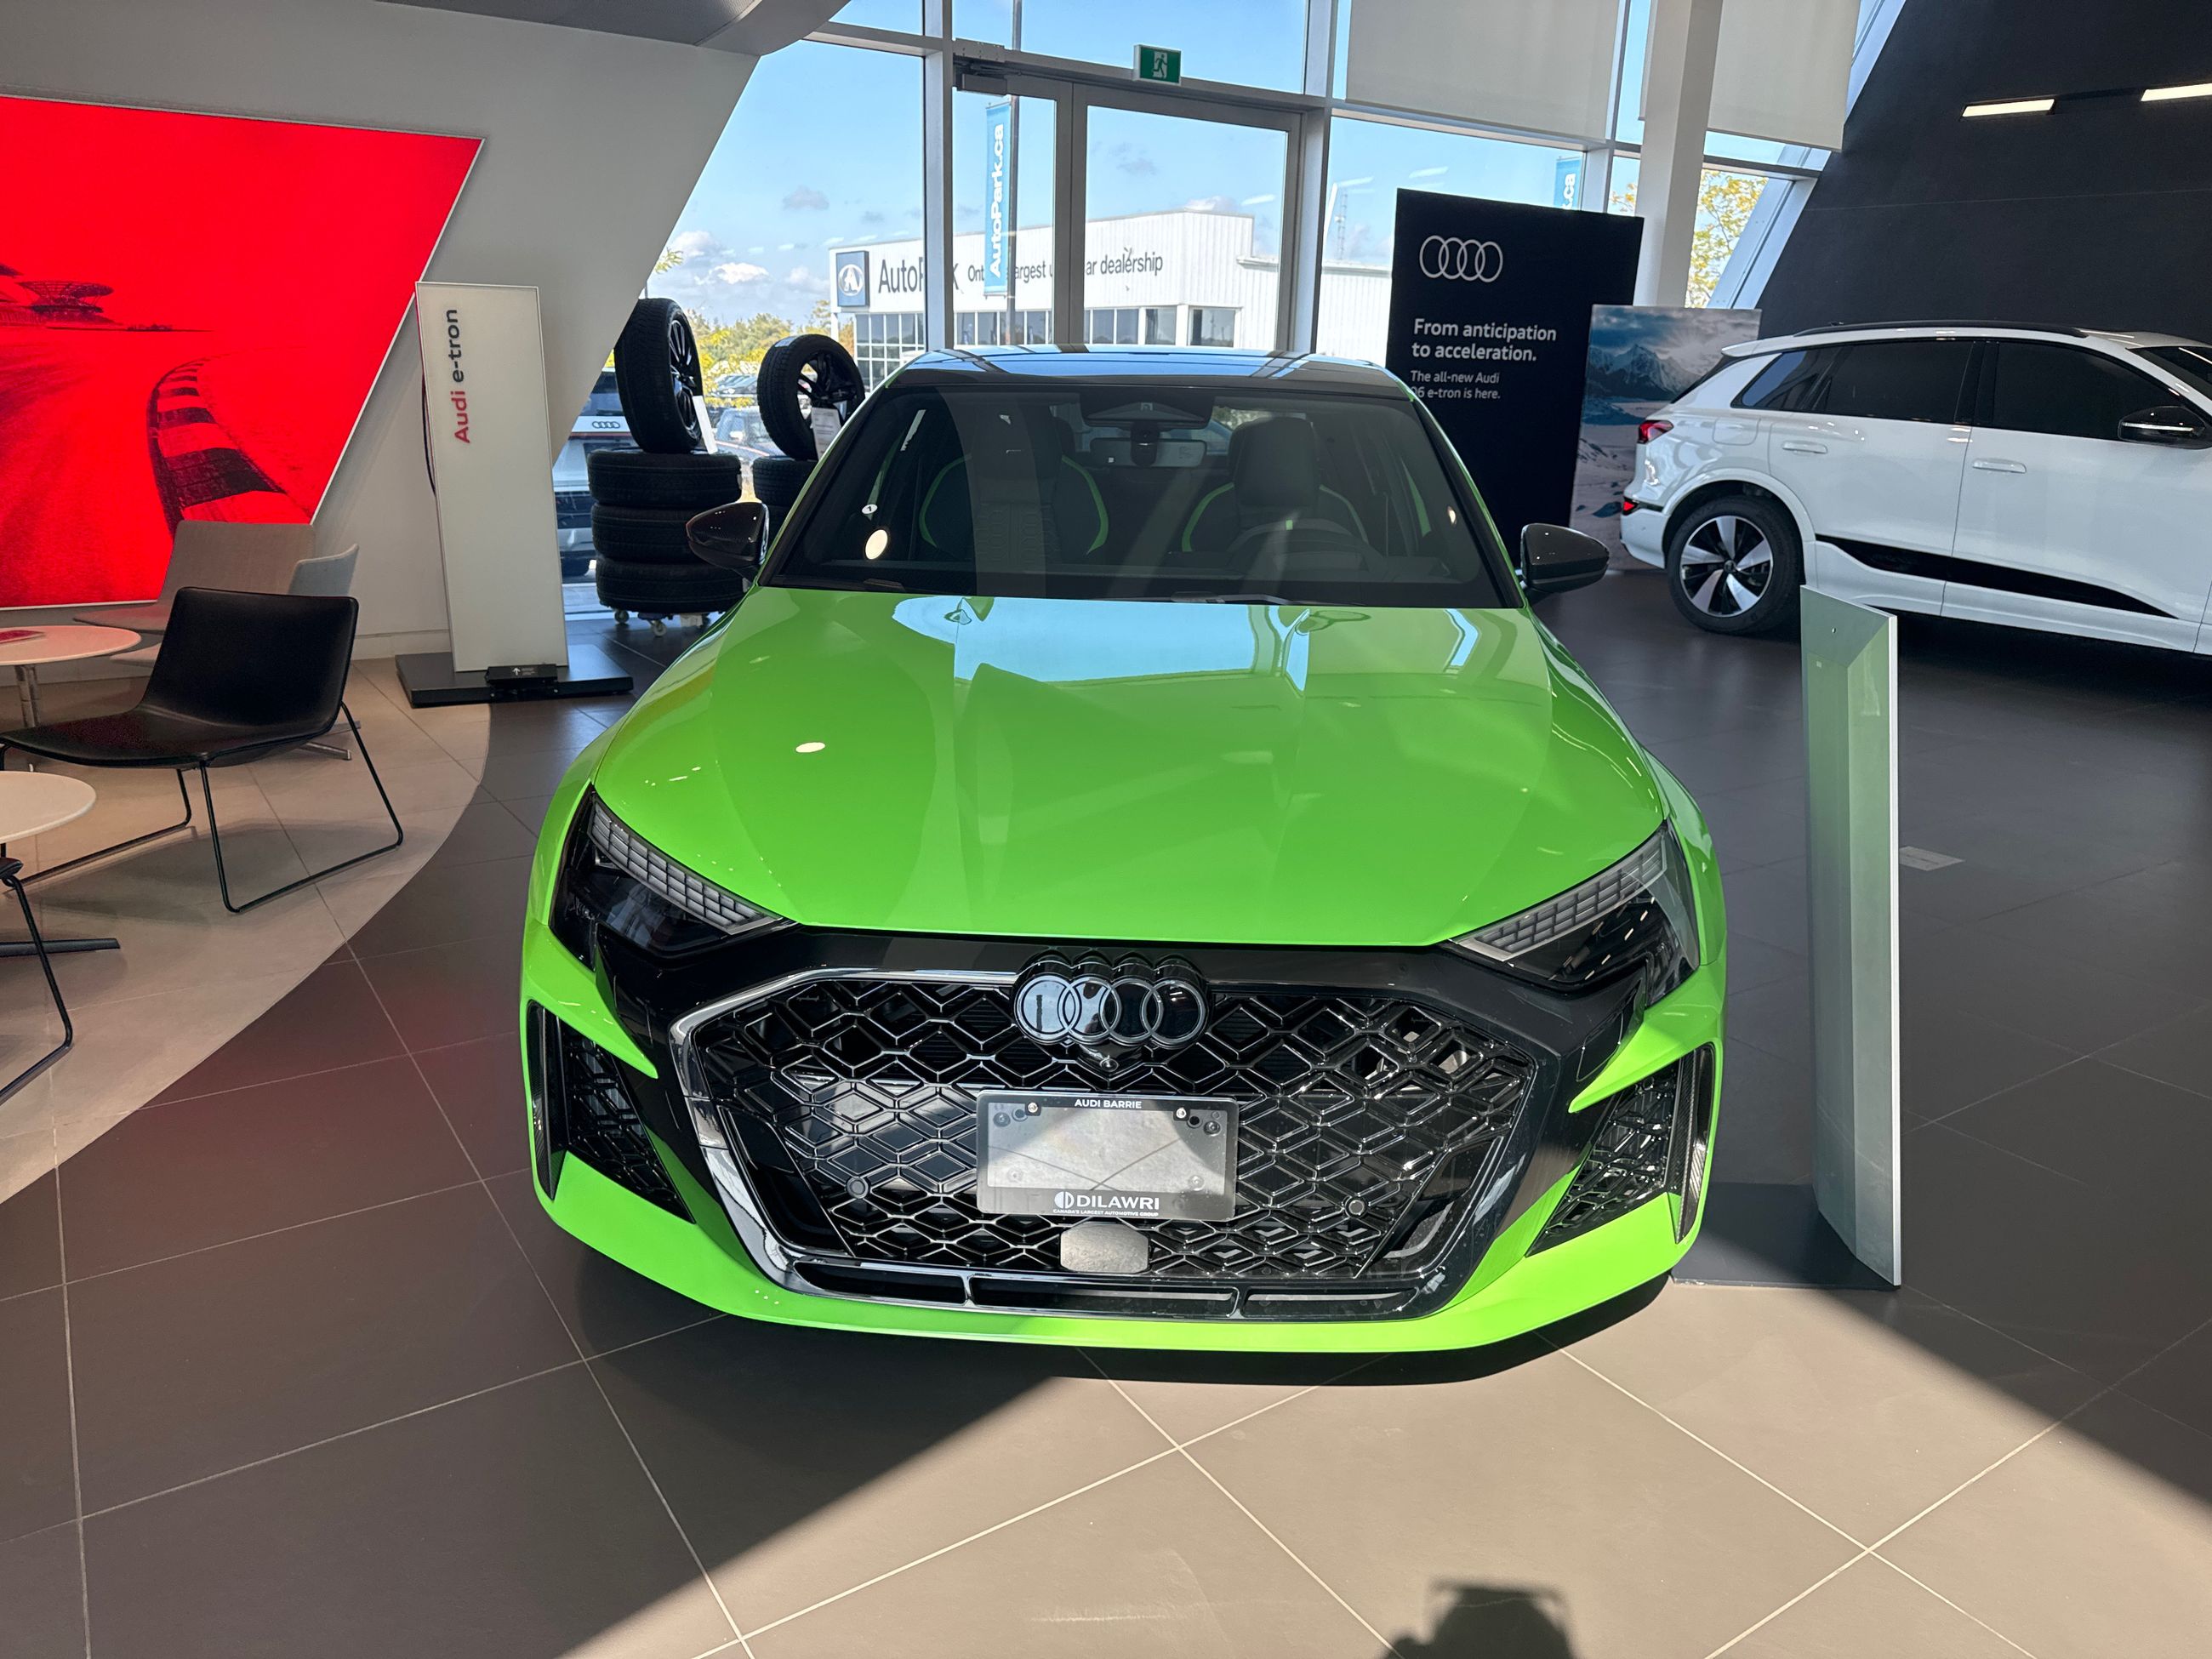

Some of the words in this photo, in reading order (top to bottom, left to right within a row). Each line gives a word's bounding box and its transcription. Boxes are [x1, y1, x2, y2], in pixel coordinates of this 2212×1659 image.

[989, 123, 1004, 279] AutoPark.ca
[878, 256, 960, 294] AutoPK
[1015, 260, 1046, 283] argest
[1086, 259, 1097, 276] ar
[1100, 252, 1164, 277] dealership
[1413, 317, 1459, 337] From
[1462, 322, 1557, 343] anticipation
[446, 309, 465, 383] e-tron
[1411, 342, 1431, 358] to
[1434, 343, 1537, 362] acceleration.
[1410, 369, 1432, 383] The
[1433, 370, 1474, 384] all-new
[1474, 372, 1501, 384] Audi
[1427, 387, 1462, 399] e-tron
[1463, 387, 1473, 399] is
[1474, 387, 1502, 400] here.
[450, 391, 470, 444] Audi
[1074, 1098, 1101, 1108] AUDI
[1103, 1100, 1143, 1109] BARRIE
[1076, 1194, 1160, 1210] DILAWRI
